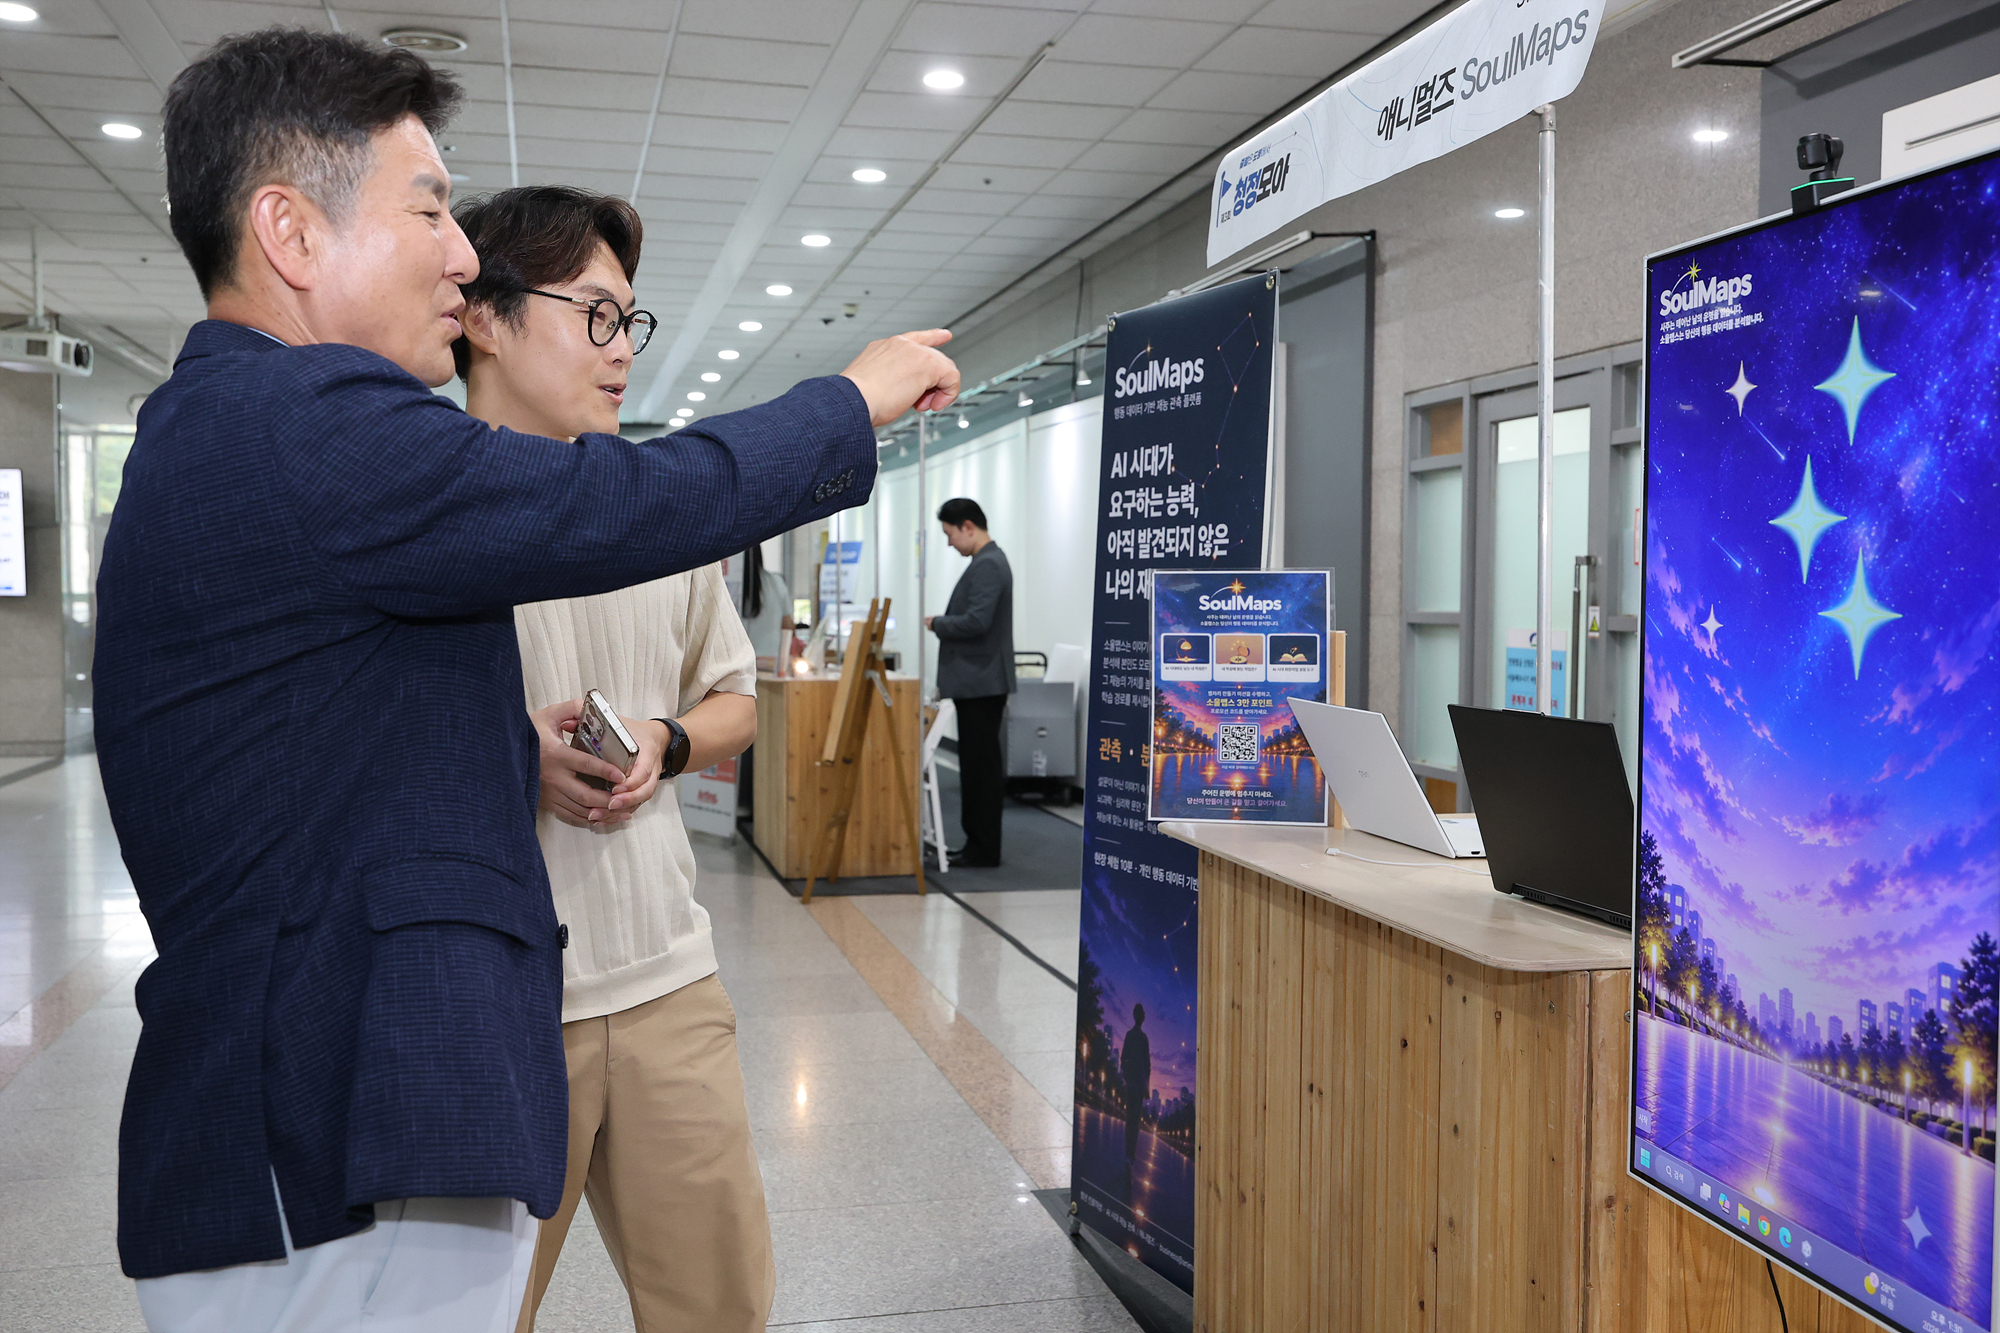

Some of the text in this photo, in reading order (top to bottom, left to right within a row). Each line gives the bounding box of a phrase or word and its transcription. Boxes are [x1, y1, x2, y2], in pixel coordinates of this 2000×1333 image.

[1377, 9, 1589, 141] 애니멀즈 SoulMaps
[1233, 152, 1291, 217] 청정모아
[1660, 274, 1752, 316] SoulMaps
[1660, 320, 1675, 332] 사주는
[1676, 316, 1691, 328] 태어난
[1703, 309, 1719, 322] 운명을
[1685, 326, 1700, 339] 당신의
[1712, 319, 1733, 332] 데이터를
[1114, 357, 1205, 398] SoulMaps
[1114, 406, 1125, 420] 행동
[1126, 403, 1143, 417] 데이터
[1144, 400, 1156, 414] 기반
[1156, 398, 1169, 411] 재능
[1183, 391, 1202, 408] 플랫폼
[1110, 442, 1174, 479] AI 시대가
[1108, 482, 1200, 520] 요구하는 능력,
[1107, 523, 1230, 560] 아직 발견되지 않은
[1105, 568, 1152, 601] 나의 재
[1199, 595, 1282, 614] SoulMaps
[1102, 674, 1109, 685] 그
[1206, 698, 1273, 707] 소울맵스 3만 포인트
[1099, 737, 1151, 767] 관측 분
[1094, 851, 1107, 867] 현장
[1107, 855, 1119, 870] 체험
[1120, 859, 1133, 873] 10분
[1139, 864, 1151, 879] 개인
[1152, 867, 1164, 883] 행동
[1165, 870, 1184, 888] 데이터
[1674, 1170, 1684, 1183] 검색
[1930, 1310, 1946, 1325] 오후
